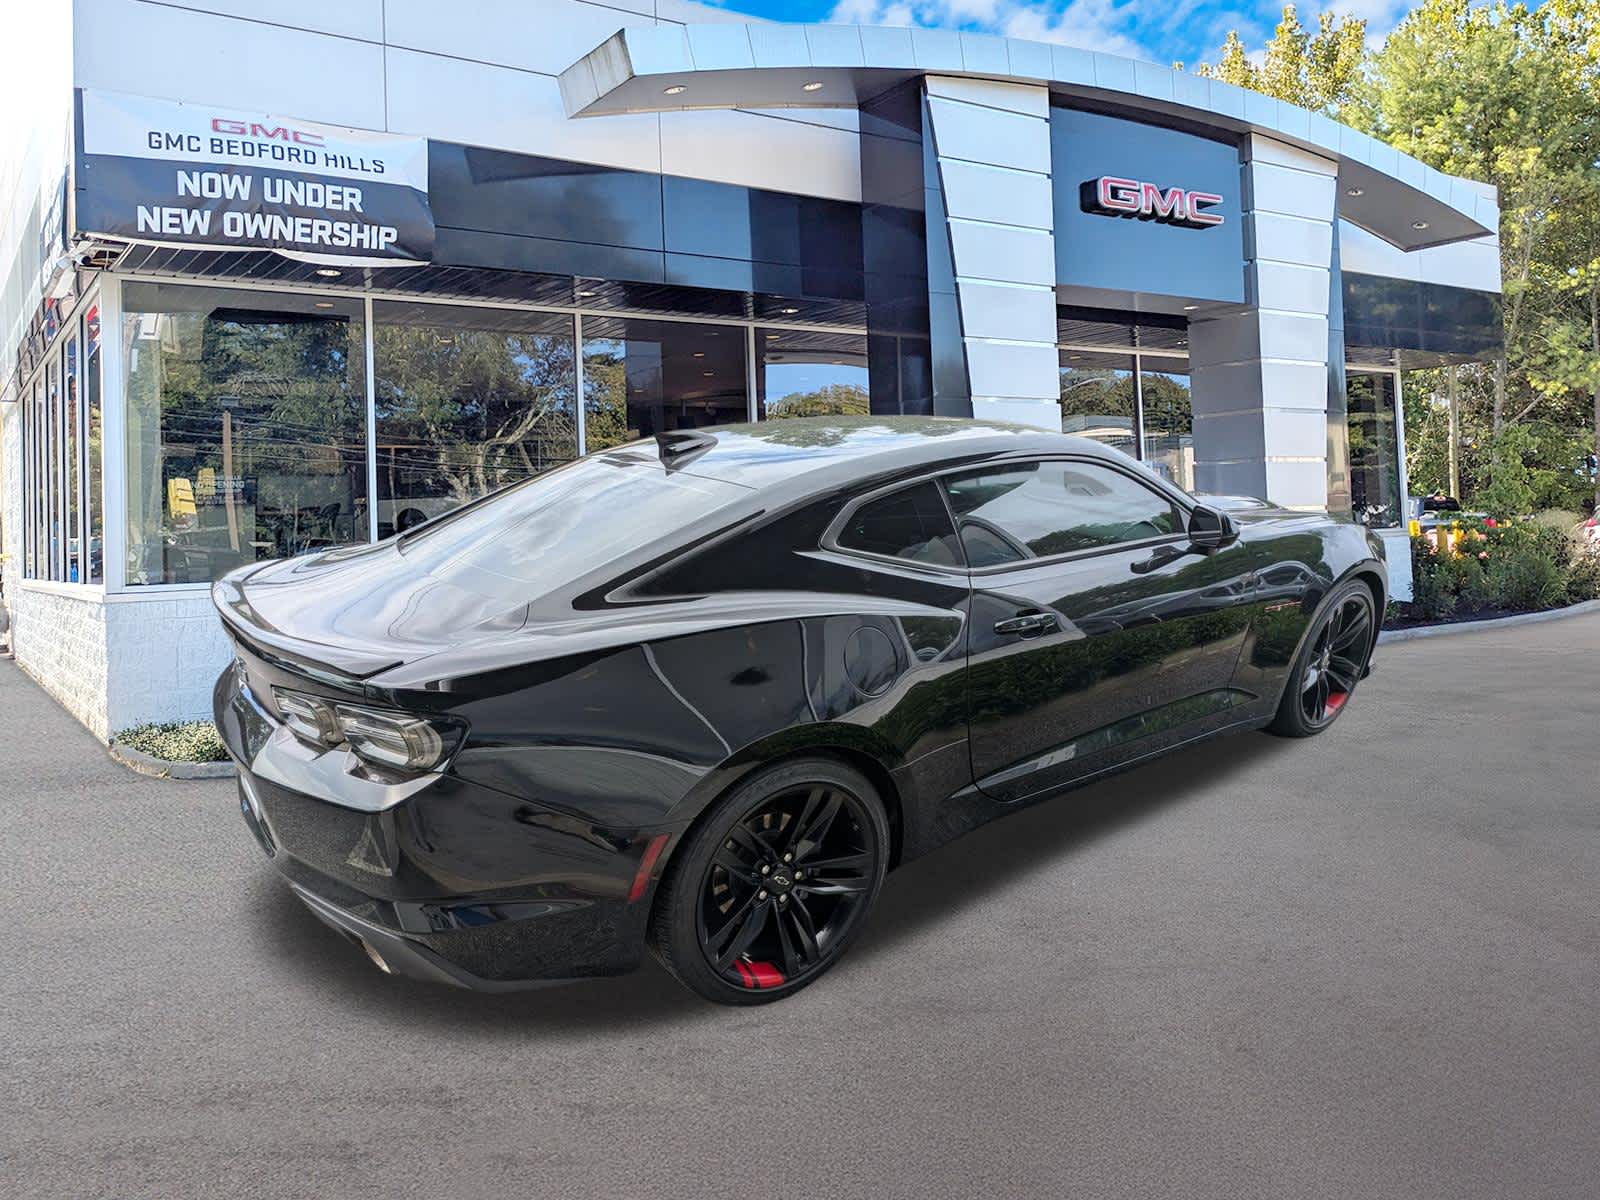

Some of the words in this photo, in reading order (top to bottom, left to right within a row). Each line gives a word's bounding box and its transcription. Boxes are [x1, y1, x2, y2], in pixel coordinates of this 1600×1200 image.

[148, 131, 201, 152] GMC
[210, 138, 316, 165] BEDFORD
[324, 153, 385, 173] HILLS
[211, 118, 326, 148] GMC
[177, 170, 252, 201] NOW
[263, 177, 363, 212] UNDER
[1098, 176, 1225, 225] GMC
[137, 205, 211, 236] NEW
[223, 211, 398, 250] OWNERSHIP
